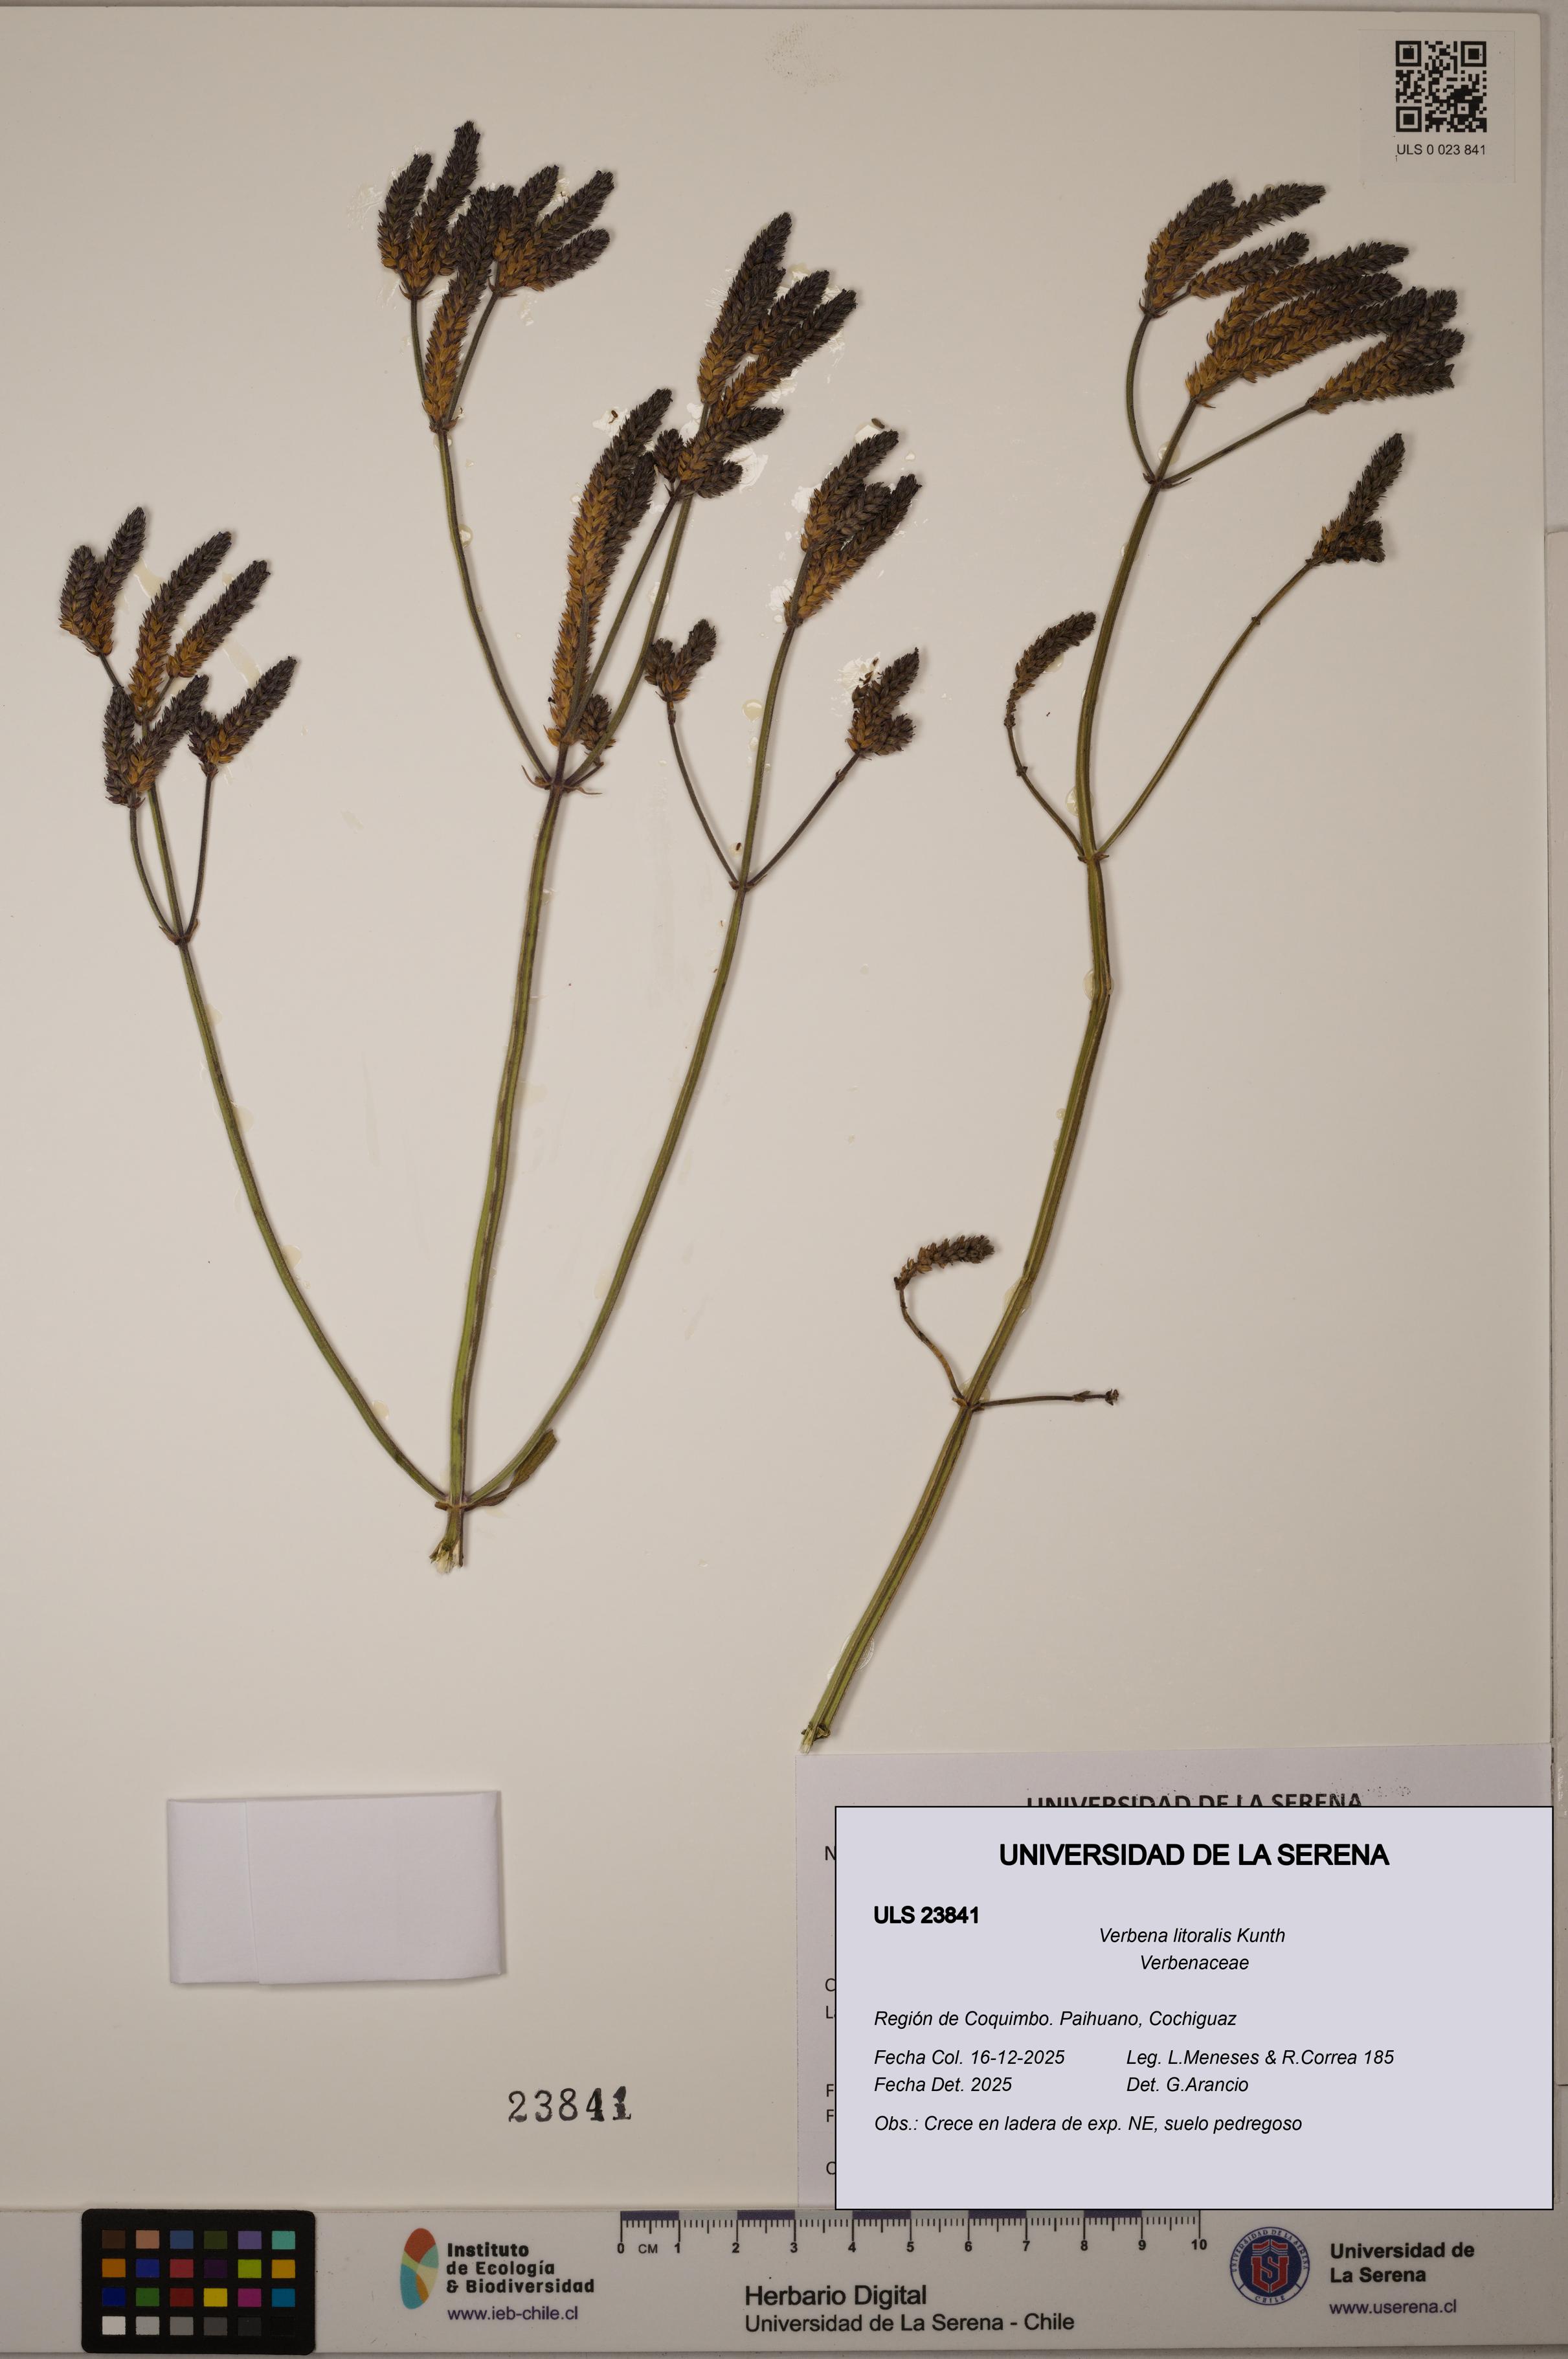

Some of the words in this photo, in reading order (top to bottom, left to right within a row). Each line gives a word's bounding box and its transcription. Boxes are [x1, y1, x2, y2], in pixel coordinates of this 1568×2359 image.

[1396, 144, 1423, 155] ULS
[1426, 144, 1434, 155] 0
[1437, 144, 1461, 155] 023
[1464, 144, 1485, 155] 841
[508, 2085, 633, 2123] 23841
[447, 2241, 530, 2257] Instituto
[617, 2242, 625, 2254] 0
[638, 2243, 658, 2254] CM
[674, 2242, 681, 2254] 1
[732, 2242, 740, 2253] 2
[790, 2242, 798, 2253] 3
[847, 2242, 857, 2253] 4
[906, 2241, 915, 2253] 5
[964, 2241, 973, 2252] 6
[1022, 2241, 1031, 2252] 7
[1080, 2240, 1088, 2252] 8
[1137, 2240, 1147, 2251] 9
[1191, 2239, 1208, 2251] 10
[1330, 2242, 1446, 2259] Universidad
[1451, 2241, 1475, 2258] de
[446, 2261, 468, 2275] de
[476, 2260, 555, 2277] Ecología
[1330, 2267, 1353, 2283] La
[1359, 2266, 1426, 2283] Serena
[446, 2279, 459, 2294] &
[466, 2278, 594, 2294] Biodiversidad
[745, 2285, 847, 2306] Herbario
[854, 2284, 926, 2309] Digital
[447, 2305, 578, 2321] www.ieb-chile.cl
[1328, 2299, 1457, 2314] www.userena.cl
[745, 2314, 862, 2332] Universidad
[869, 2314, 894, 2332] de
[901, 2314, 925, 2332] La
[932, 2313, 1003, 2331] Serena
[1024, 2312, 1075, 2331] Chile
